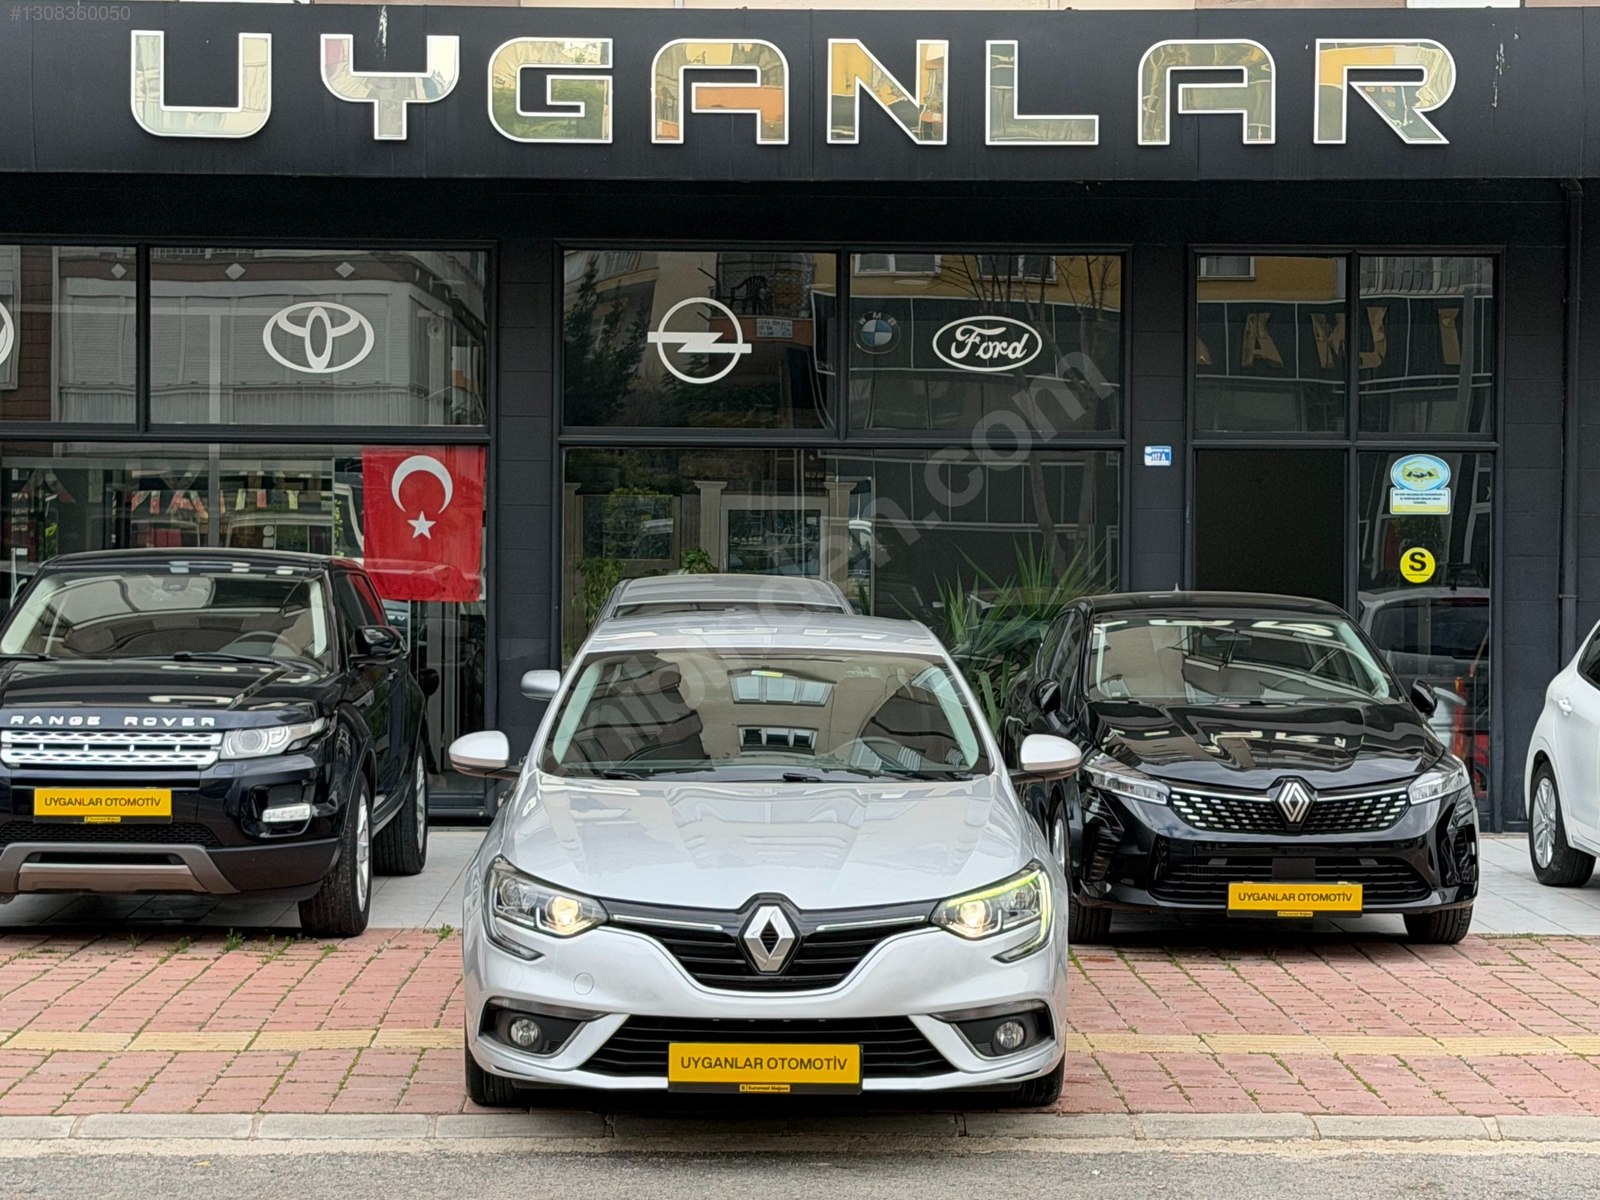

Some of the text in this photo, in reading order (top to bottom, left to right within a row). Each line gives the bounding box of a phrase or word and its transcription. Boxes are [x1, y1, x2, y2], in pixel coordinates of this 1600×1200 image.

[130, 29, 1458, 147] UYGANLAR
[950, 324, 1030, 360] Ford
[1408, 551, 1427, 572] S
[10, 715, 216, 727] RANGE ROVER
[44, 796, 162, 807] UYGANLAR OTOMOTİV
[1238, 891, 1353, 903] UYGANLAR OTOMOTİV
[680, 1055, 848, 1071] UYGANLAR OTOMOTİV
